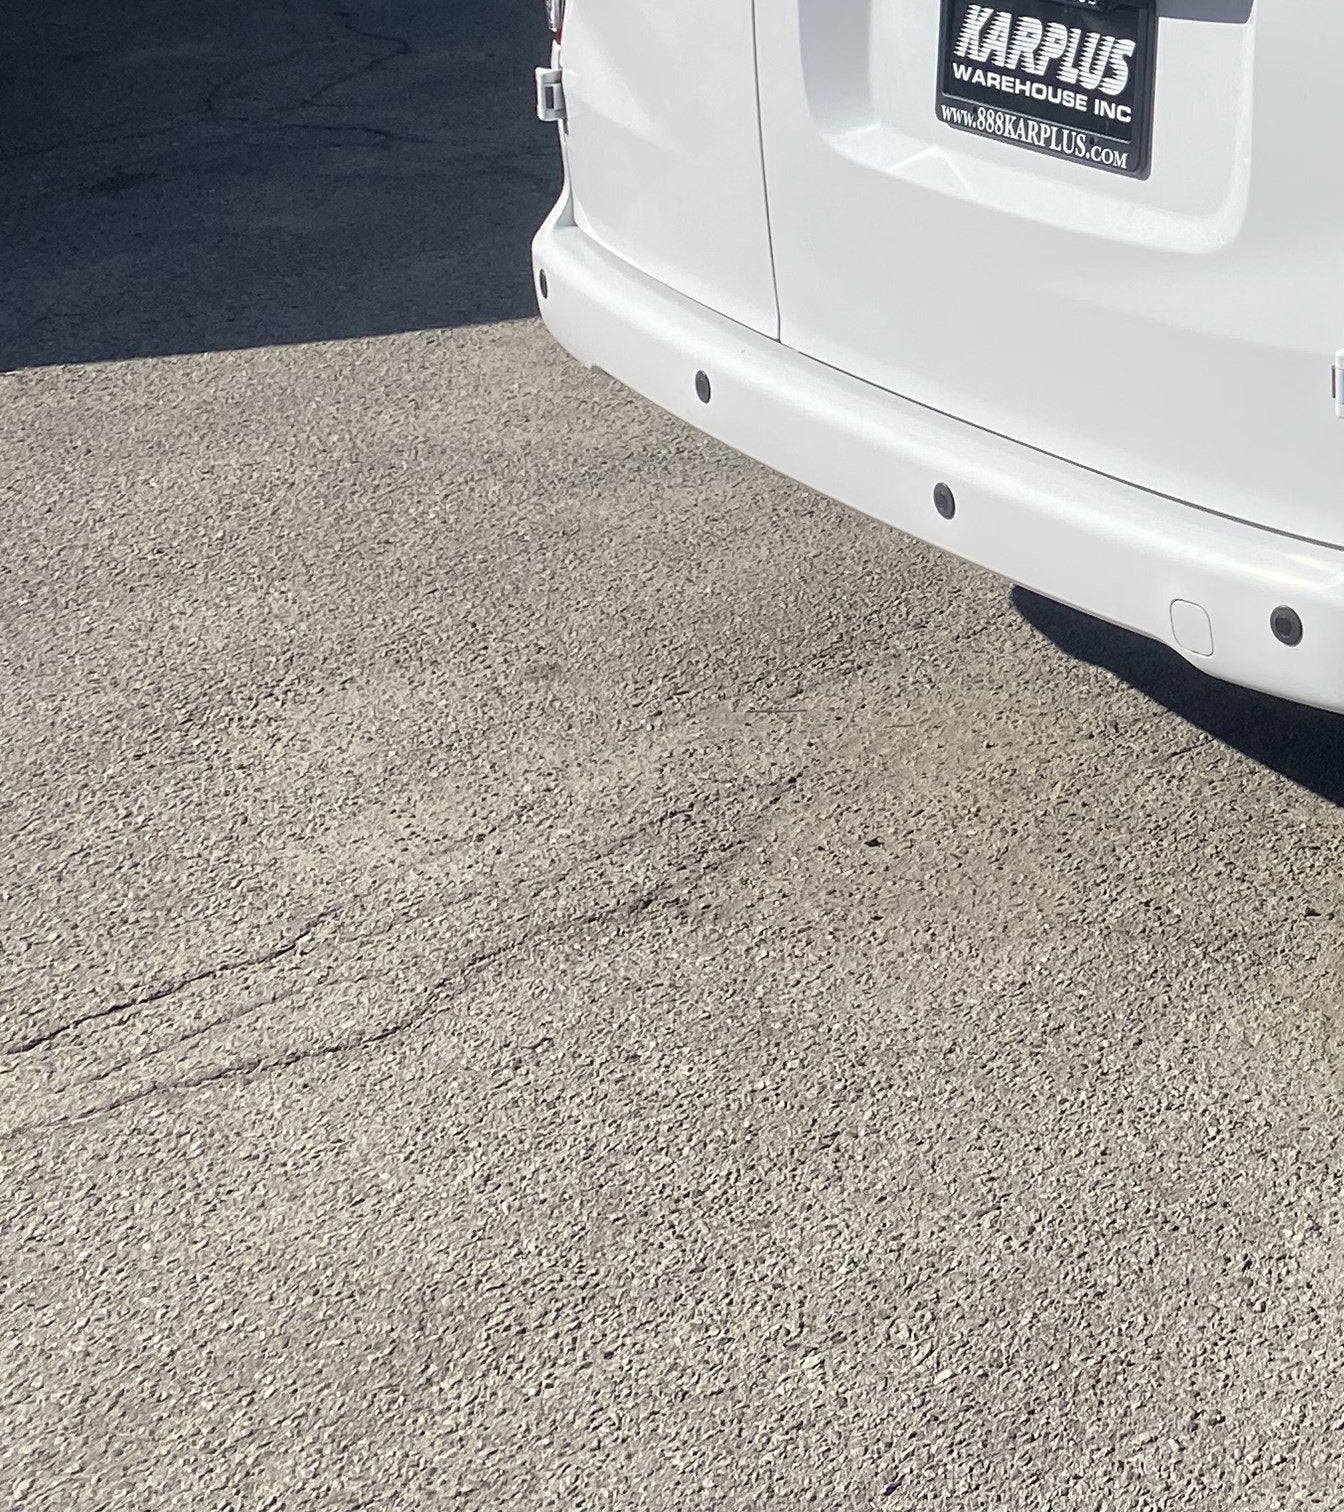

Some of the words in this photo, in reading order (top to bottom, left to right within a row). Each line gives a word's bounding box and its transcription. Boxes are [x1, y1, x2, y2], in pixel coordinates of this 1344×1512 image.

[953, 3, 1137, 97] KARPLUS
[952, 61, 1088, 113] WAREHOUSE
[1094, 99, 1132, 124] INC
